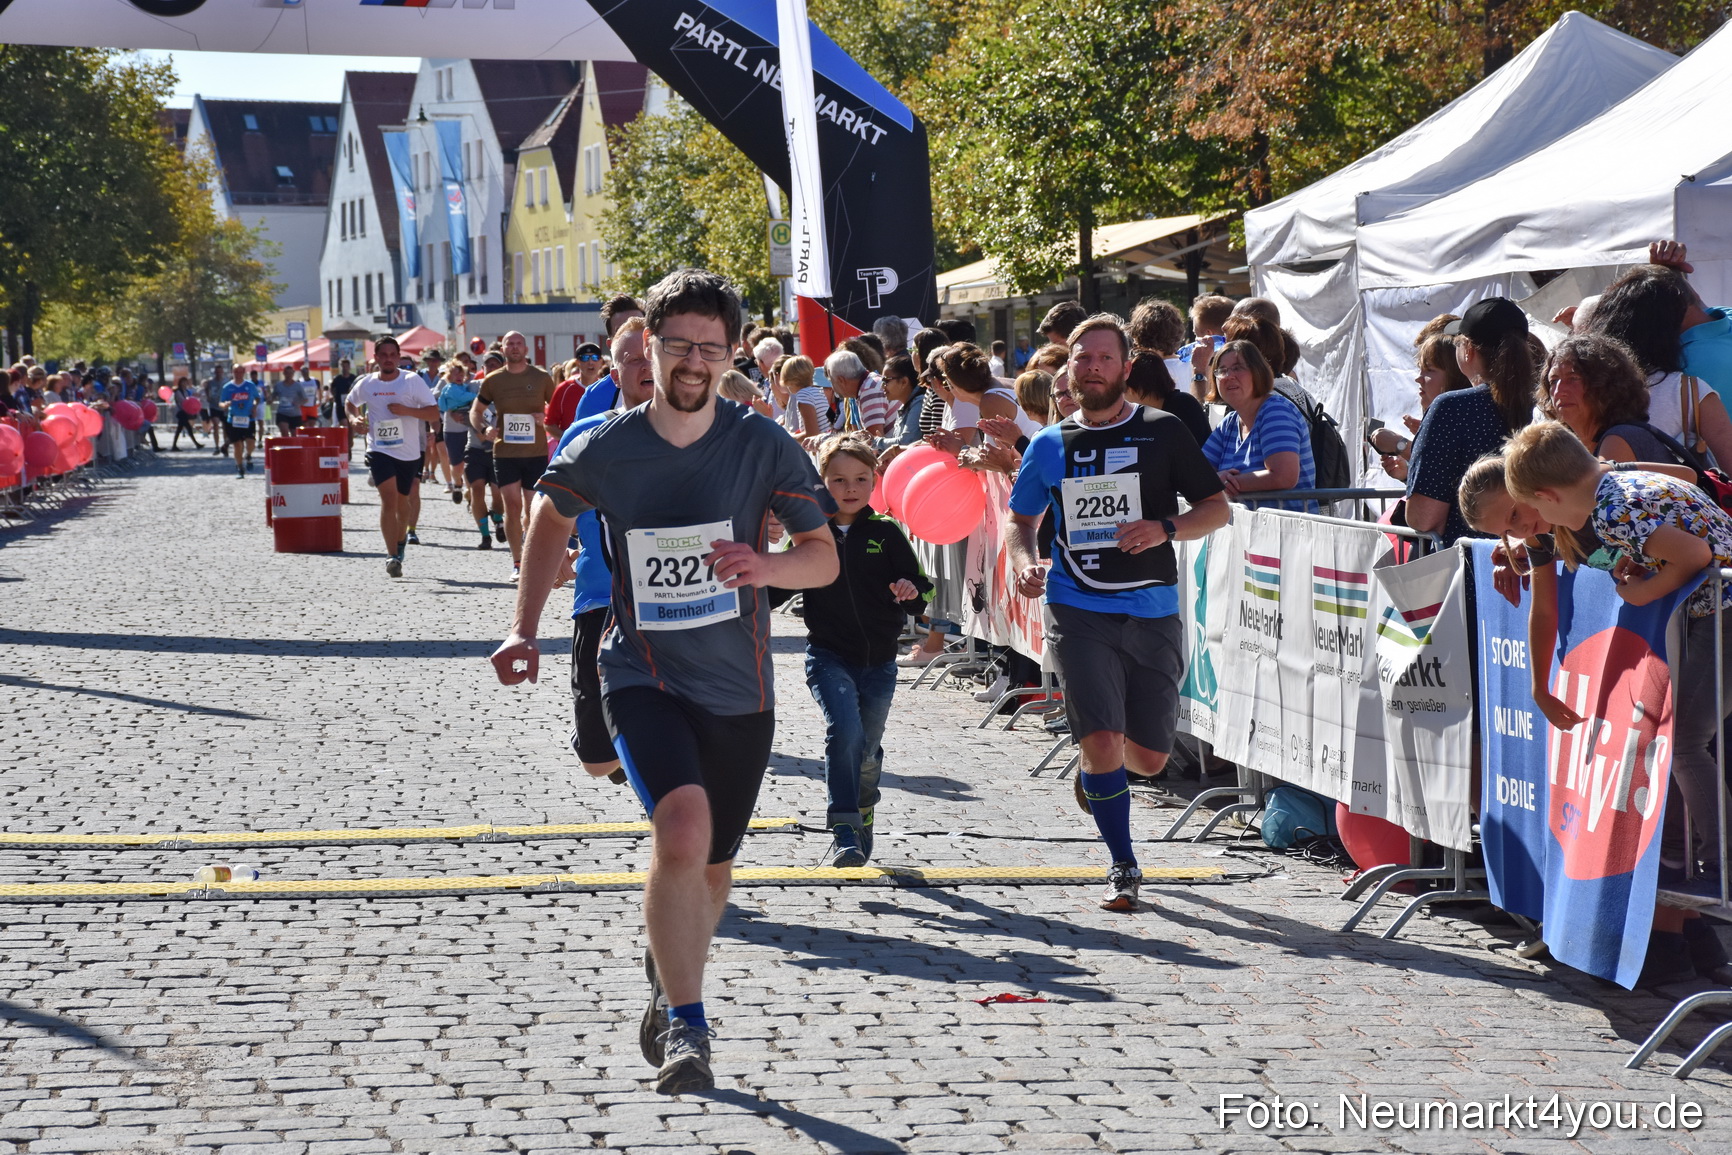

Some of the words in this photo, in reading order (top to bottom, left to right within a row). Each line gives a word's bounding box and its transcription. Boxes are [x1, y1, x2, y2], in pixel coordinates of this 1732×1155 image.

[673, 12, 748, 71] PARTL
[752, 58, 888, 146] NEMARKT
[377, 426, 400, 437] 2272
[508, 421, 531, 432] 2075
[1083, 480, 1119, 493] BOCK
[1075, 493, 1131, 520] 2284
[656, 534, 703, 549] BOCK
[1087, 530, 1116, 541] Marku
[645, 552, 716, 588] 2327
[654, 591, 676, 599] PARTL
[676, 588, 709, 599] Neumarkt
[657, 600, 716, 619] Bernhard
[1491, 636, 1526, 670] STORE
[1407, 697, 1447, 714] genießen
[1494, 704, 1533, 742] ONLINE
